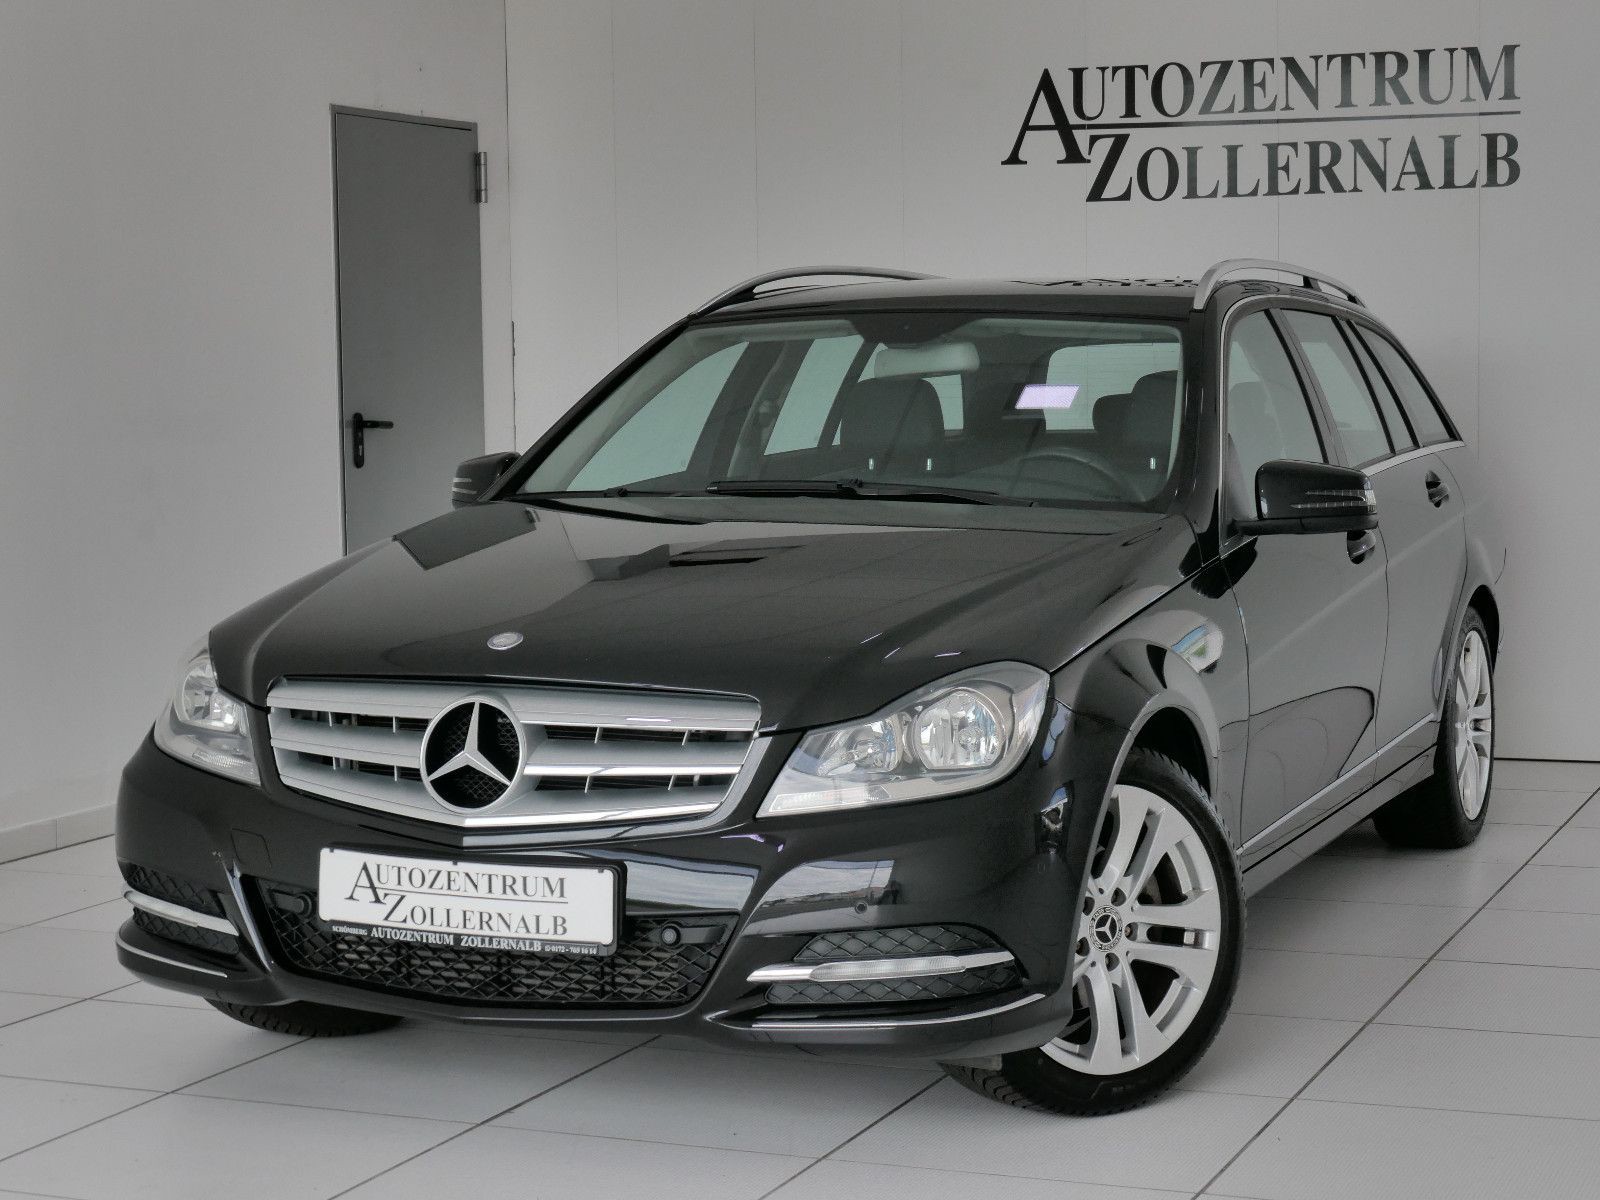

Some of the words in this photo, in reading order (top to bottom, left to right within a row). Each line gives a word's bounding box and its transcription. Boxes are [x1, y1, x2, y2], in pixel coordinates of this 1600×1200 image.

[1001, 44, 1521, 165] AUTOZENTRUM
[1085, 132, 1521, 202] ZOLLERNALB
[344, 861, 567, 903] AUTOZENTRUM
[382, 893, 568, 936] ZOLLERNALB
[370, 926, 454, 946] AUTOZENTRUM
[460, 935, 542, 952] ZOLLERNALB
